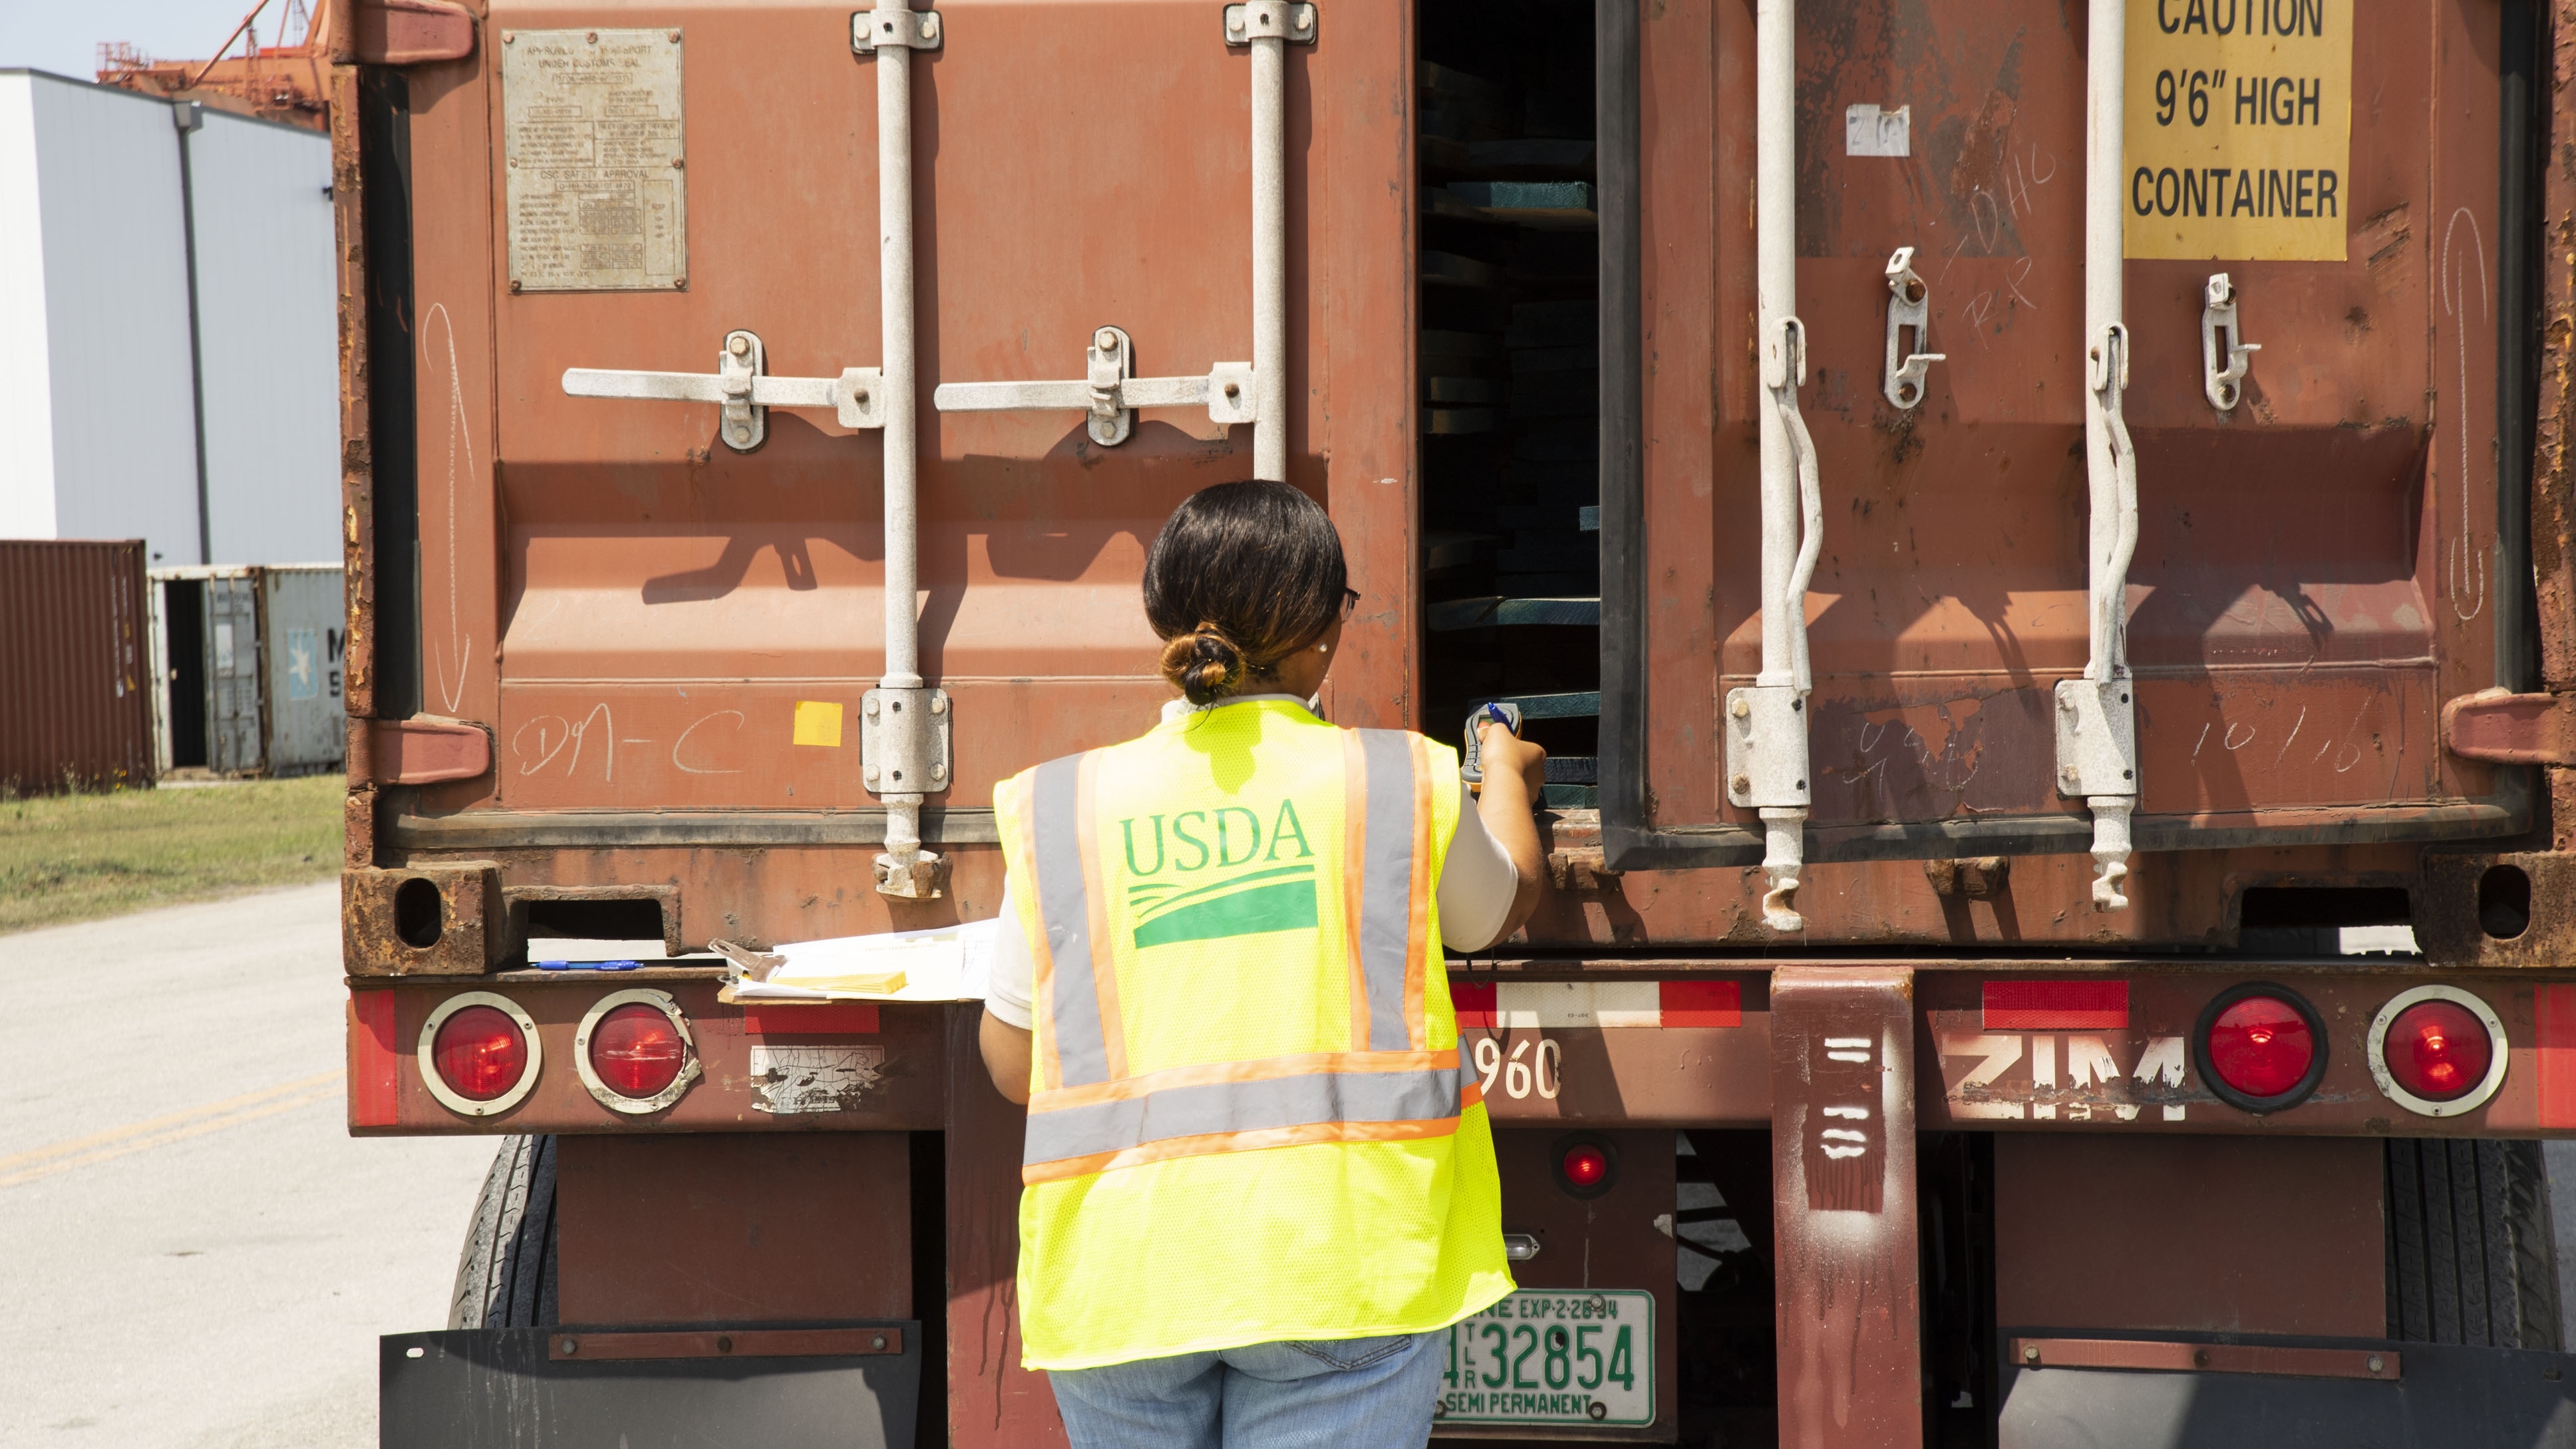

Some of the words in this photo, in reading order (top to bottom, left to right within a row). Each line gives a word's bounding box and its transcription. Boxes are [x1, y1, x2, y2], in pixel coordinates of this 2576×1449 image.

[2158, 0, 2323, 37] CAUTION
[2235, 77, 2320, 126] HIGH
[604, 170, 649, 179] APPROVAL
[2132, 166, 2338, 218] CONTAINER
[1119, 798, 1315, 877] USDA
[1475, 1037, 1562, 1100] 960
[1940, 1035, 2186, 1122] ZIM
[1481, 1323, 1635, 1391] 32854
[1445, 1393, 1484, 1412] SEMI
[1490, 1394, 1592, 1415] PERMANENT
